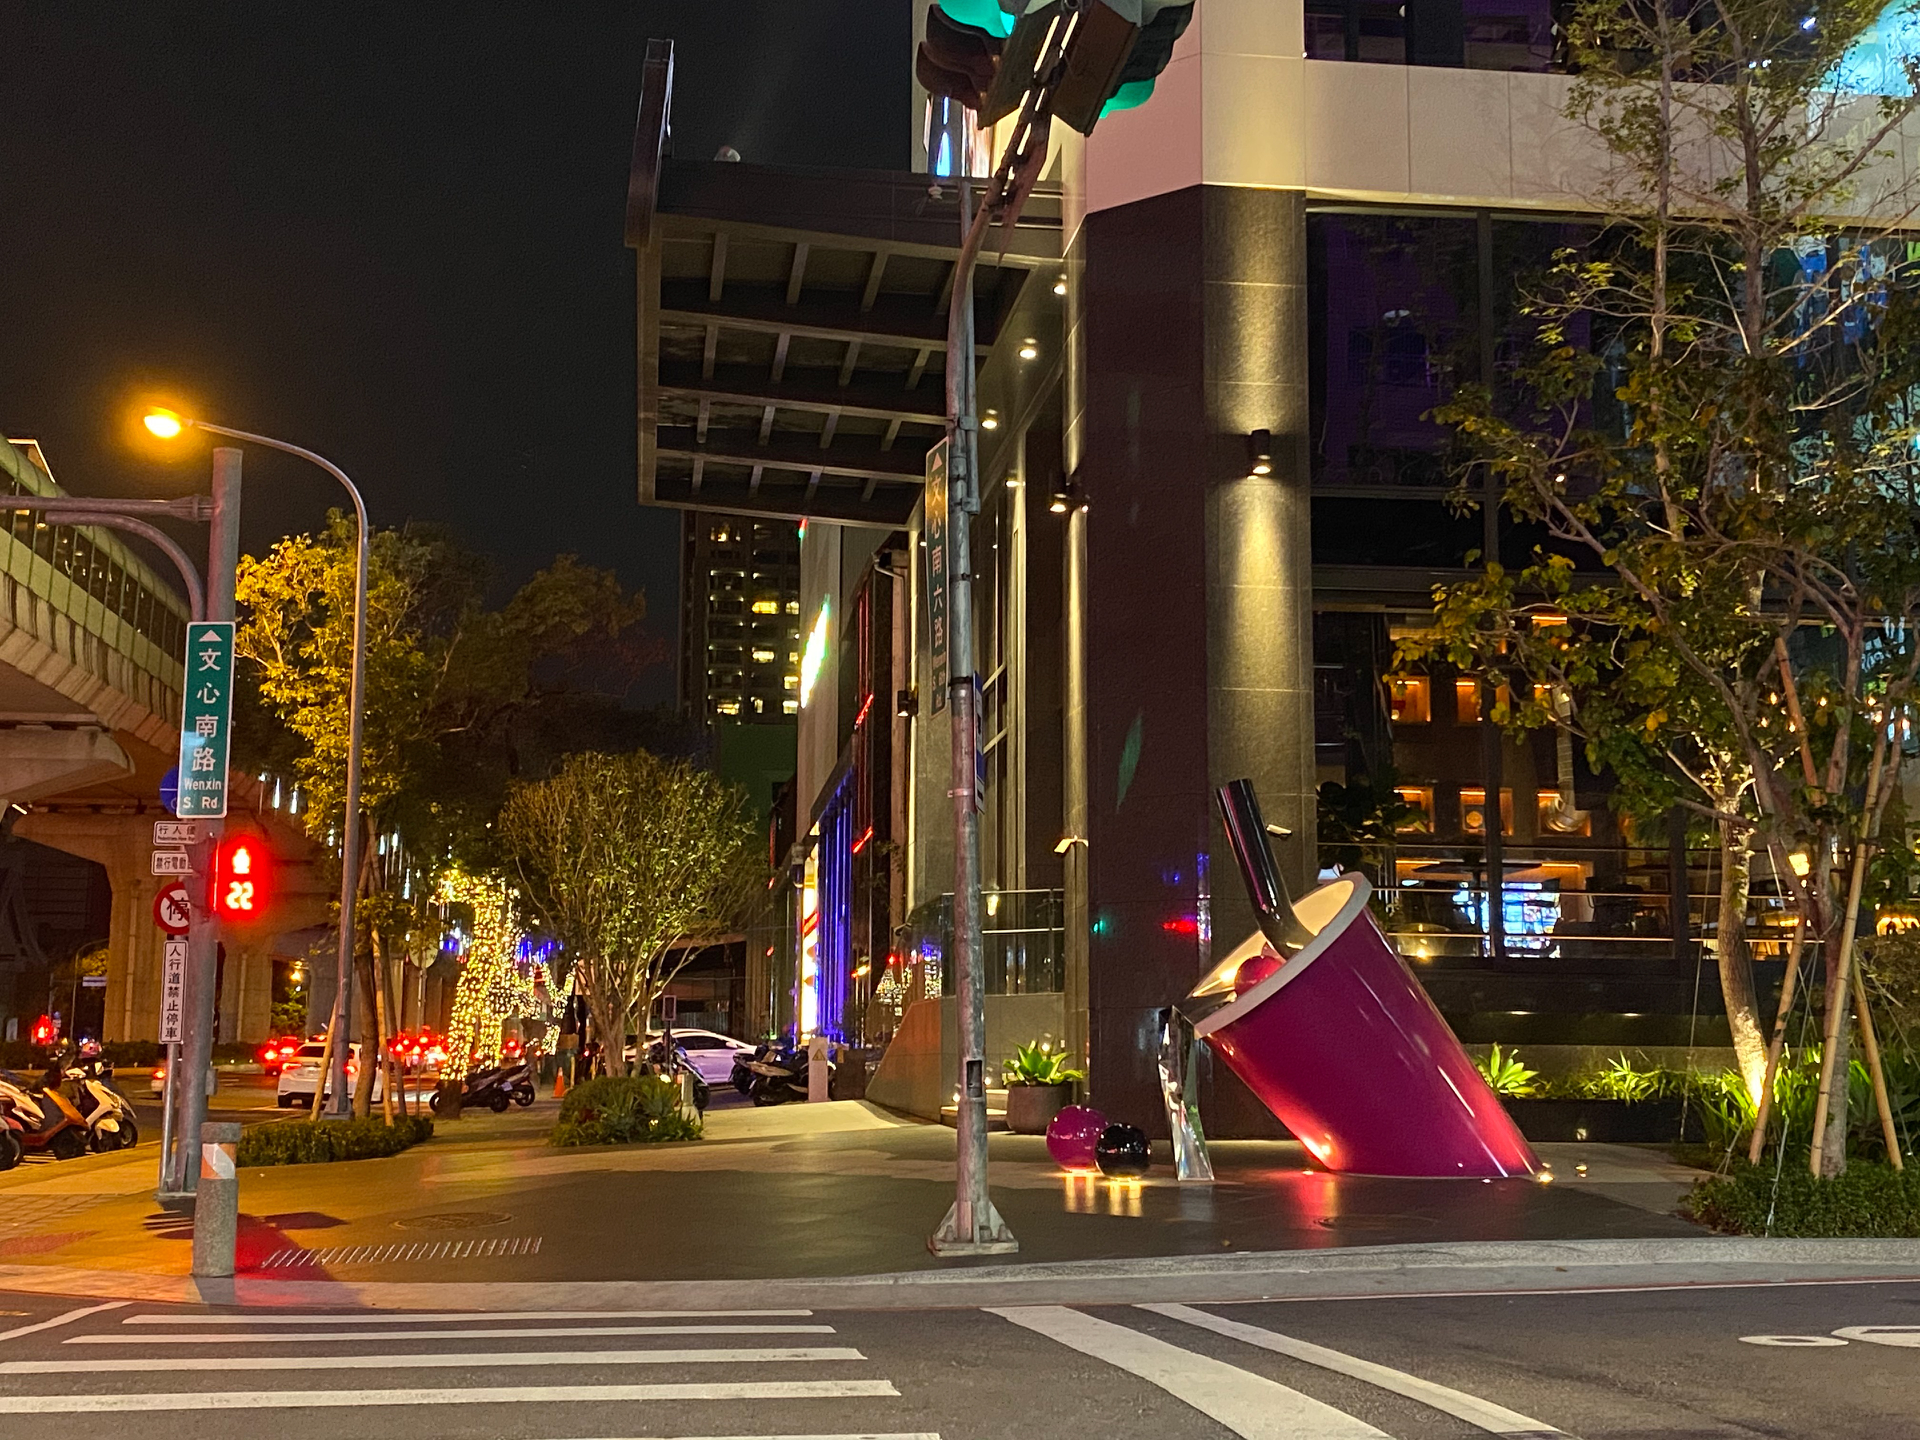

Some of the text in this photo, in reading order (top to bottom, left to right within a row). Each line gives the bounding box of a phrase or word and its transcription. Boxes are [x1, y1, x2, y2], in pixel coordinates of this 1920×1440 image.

[931, 475, 943, 647] 文心南六路
[191, 648, 222, 772] 文心南路
[184, 777, 222, 791] Wenxin
[226, 881, 254, 910] 22
[164, 945, 181, 1039] 人行道禁止停車
